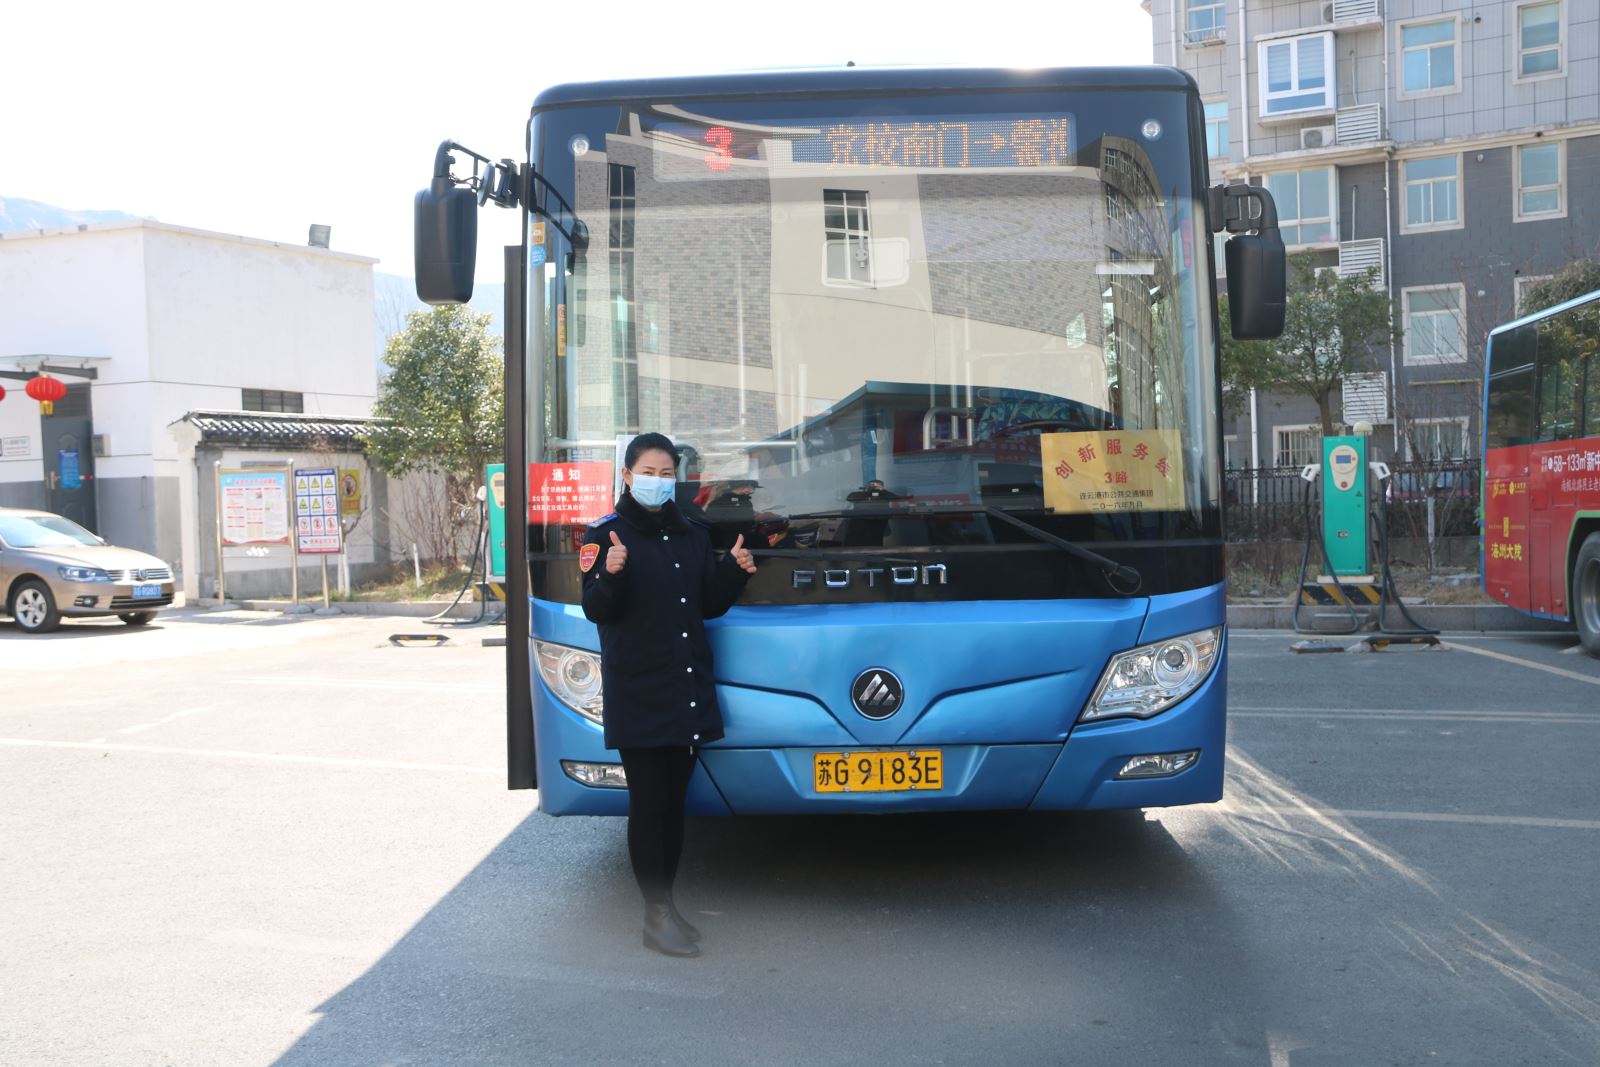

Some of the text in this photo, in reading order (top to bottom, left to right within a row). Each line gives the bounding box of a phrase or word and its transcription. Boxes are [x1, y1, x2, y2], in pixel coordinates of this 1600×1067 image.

[704, 126, 733, 171] 3
[552, 468, 580, 481] 通知
[1104, 471, 1128, 484] 3路
